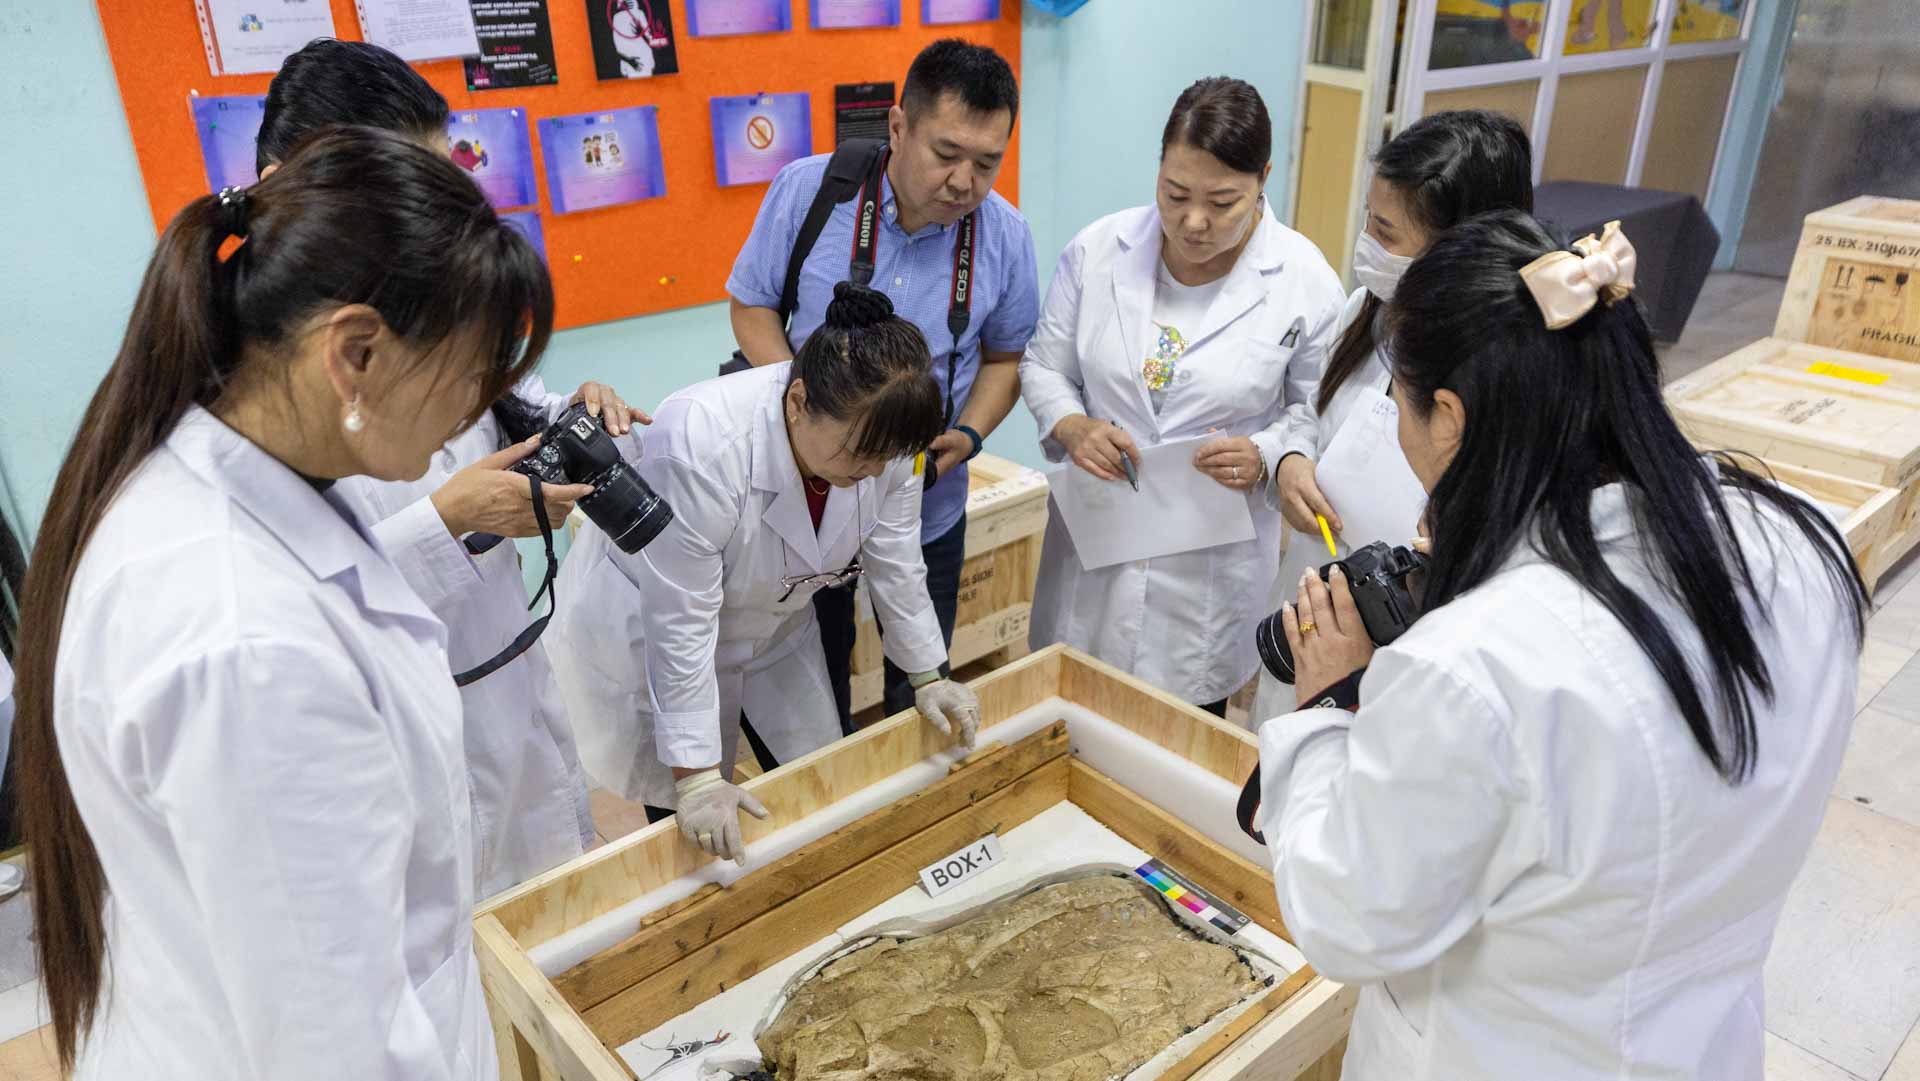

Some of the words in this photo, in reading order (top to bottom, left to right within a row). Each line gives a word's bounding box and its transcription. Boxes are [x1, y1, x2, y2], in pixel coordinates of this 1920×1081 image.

[859, 200, 875, 248] Canon
[960, 249, 971, 266] 7D
[956, 269, 969, 302] EOS
[930, 844, 993, 888] BOX-1
